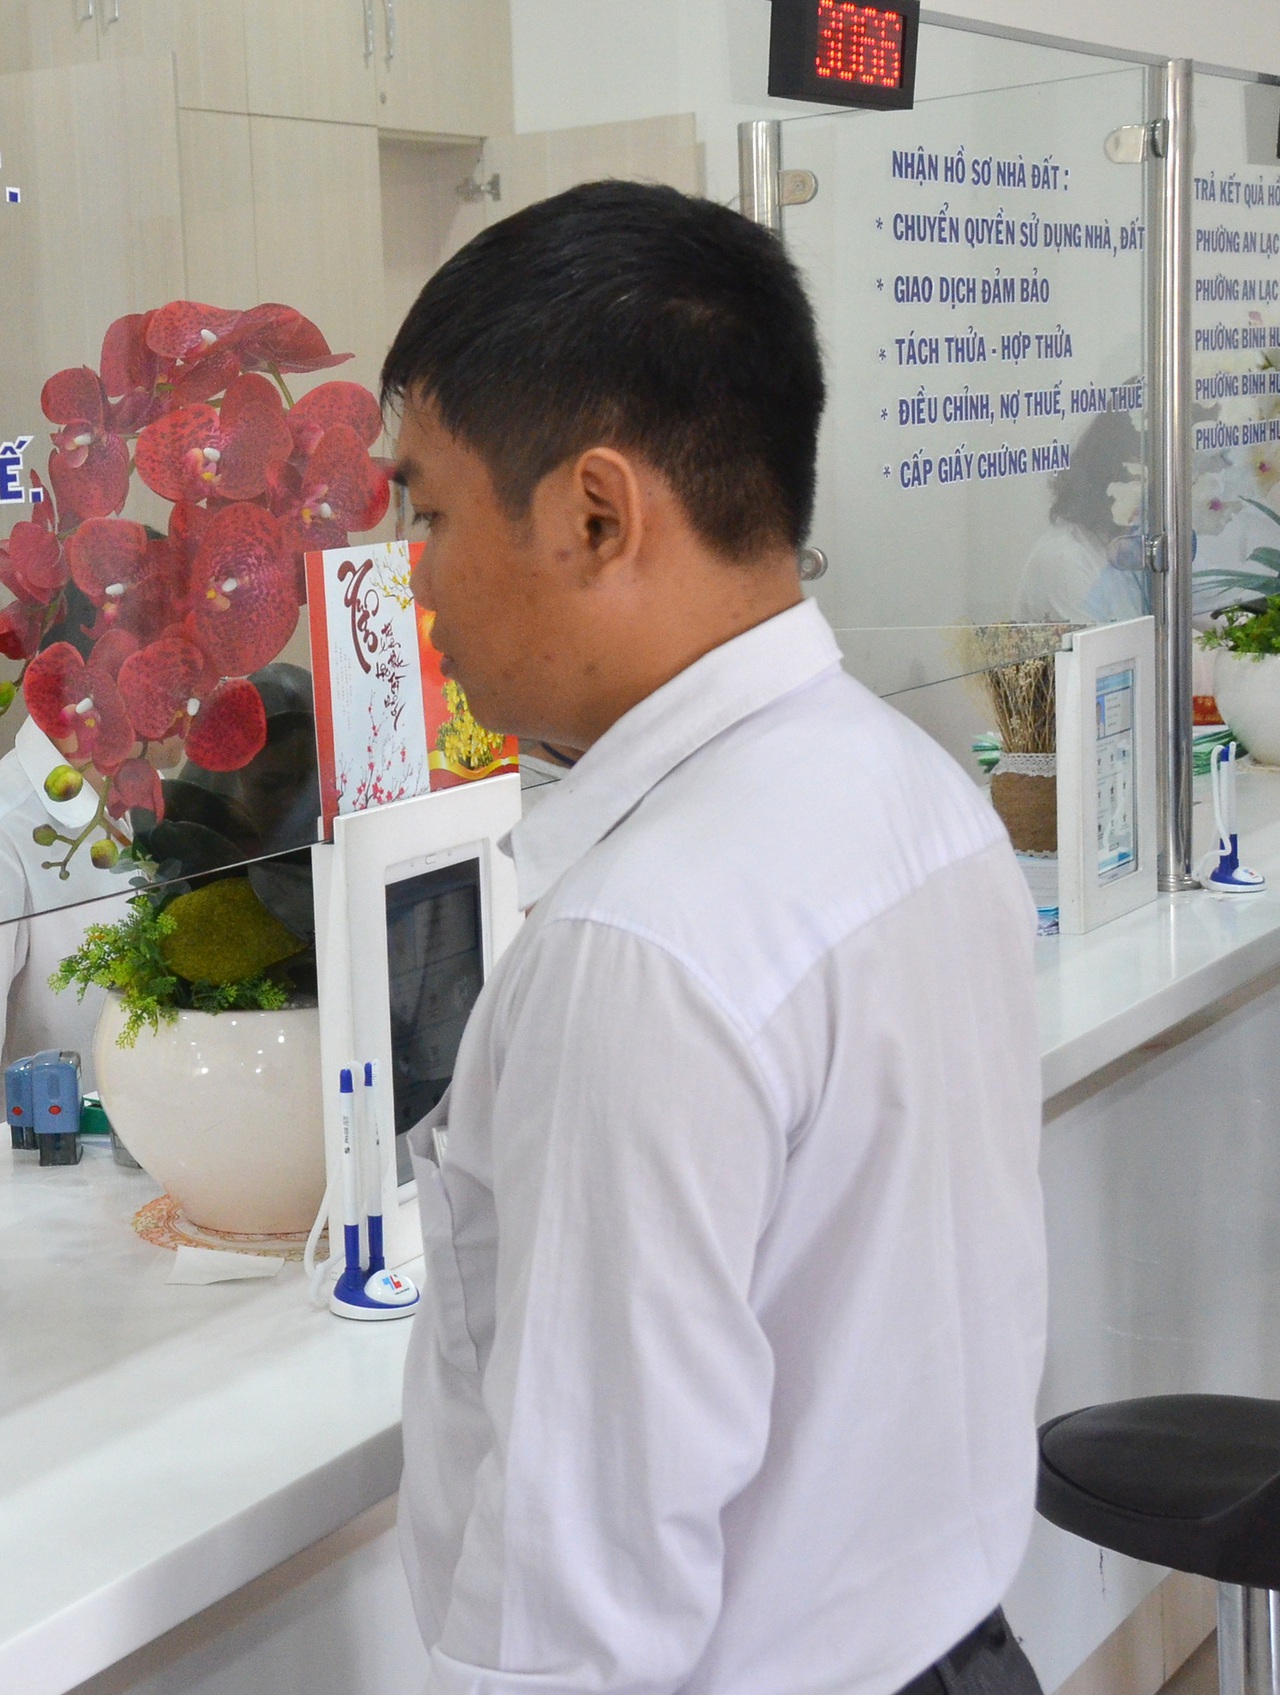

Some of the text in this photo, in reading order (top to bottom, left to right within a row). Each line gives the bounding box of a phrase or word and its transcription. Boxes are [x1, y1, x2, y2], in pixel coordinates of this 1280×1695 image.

[890, 145, 939, 187] NHẬN
[943, 144, 967, 185] HỒ
[970, 155, 993, 187] SƠ
[995, 155, 1028, 189] NHÀ
[1194, 171, 1215, 201] TRẢ
[1220, 173, 1241, 203] KẾT
[1244, 175, 1264, 209] QUẢ
[891, 201, 960, 243] CHUYỂN
[963, 207, 1016, 248] QUYỀN
[1018, 212, 1041, 248] SỬ
[1043, 221, 1083, 253] DỤNG
[1243, 231, 1257, 253] AN
[1260, 232, 1279, 259] LẠC
[892, 267, 1051, 310] GIAO DỊCH ĐẢM BẢO
[1242, 280, 1256, 301] AN
[1259, 280, 1279, 305] LẠC
[894, 330, 940, 366] TÁCH
[944, 325, 987, 364] THỬA
[1000, 331, 1033, 366] HỢP
[1034, 324, 1074, 360] THỬA
[1242, 321, 1266, 349] BÌNH
[897, 385, 939, 426] ĐIỀU
[998, 391, 1021, 425] NỢ
[1070, 381, 1108, 414] HOÀN
[1110, 376, 1146, 411] THUẾ
[1242, 368, 1266, 395] BÌNH
[1242, 417, 1267, 445] BÌNH
[898, 439, 1071, 489] CẤP GIẤY CHỨNG NHẬN
